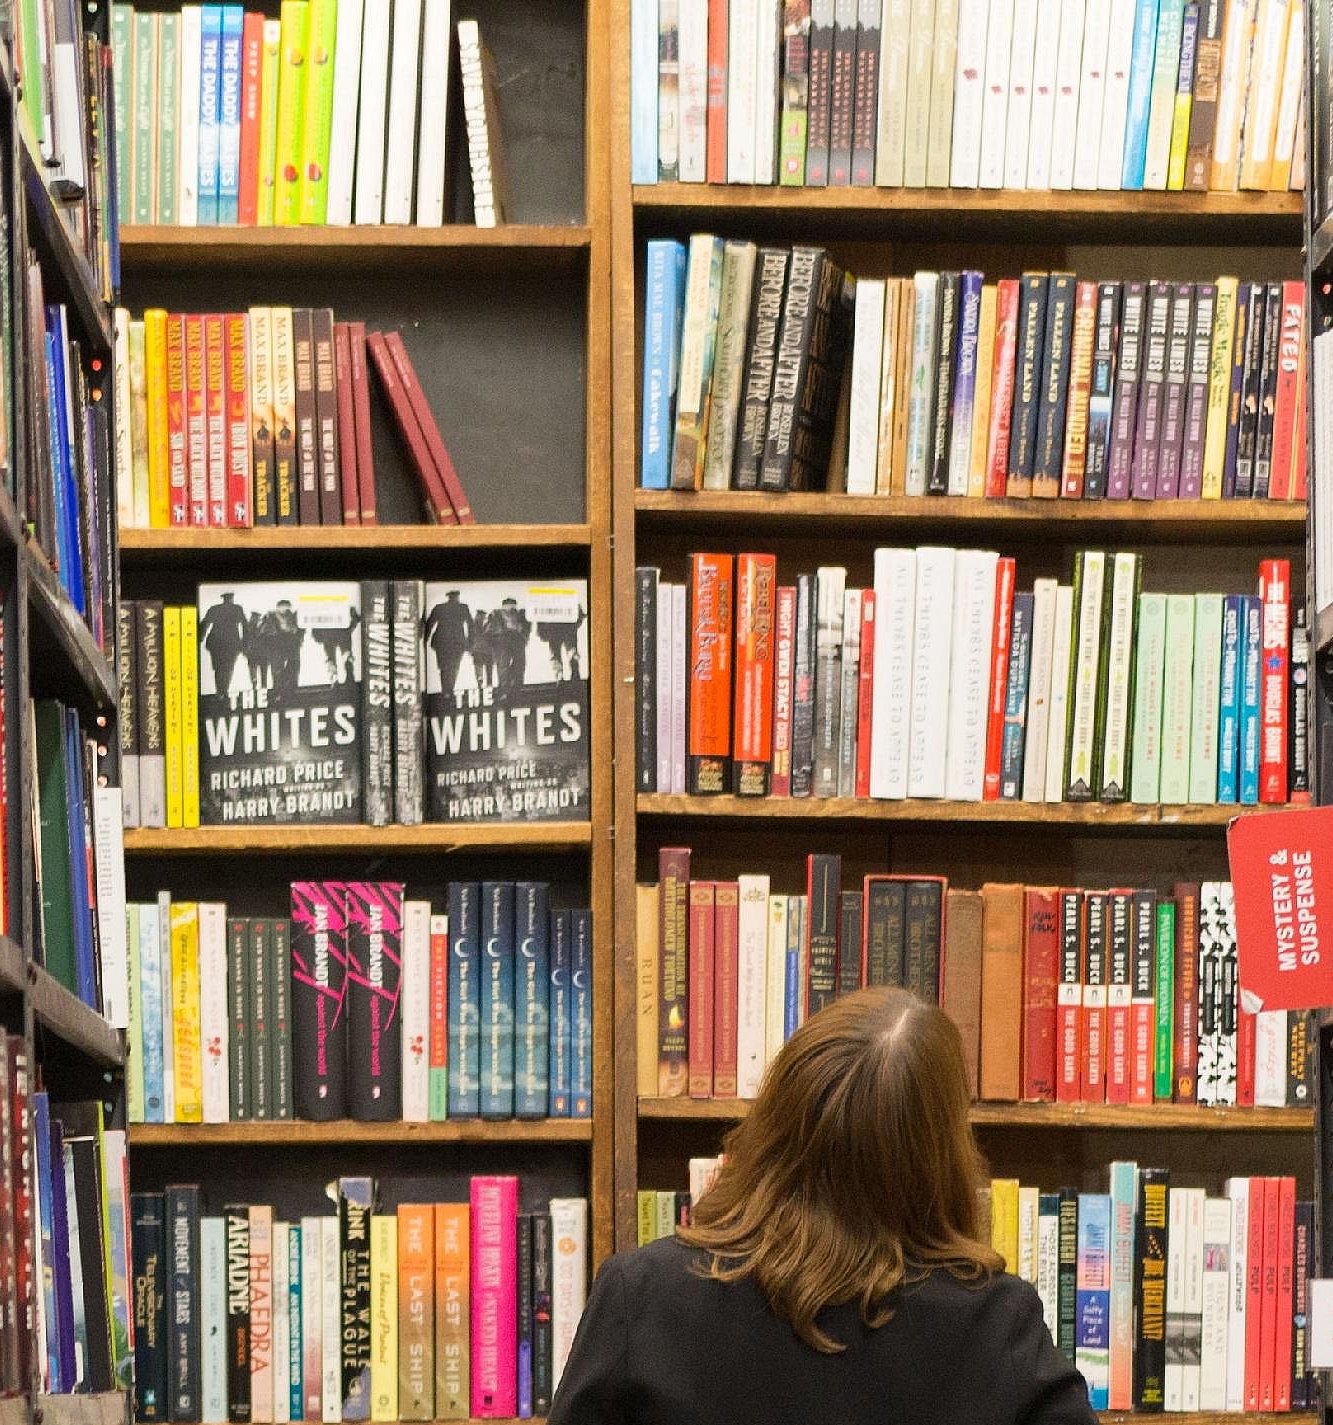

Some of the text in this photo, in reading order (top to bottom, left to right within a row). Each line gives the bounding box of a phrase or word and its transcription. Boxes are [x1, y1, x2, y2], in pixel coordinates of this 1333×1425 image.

[758, 254, 787, 318] BEFORE
[787, 254, 814, 318] BEFORE
[1023, 302, 1039, 402] FALLEN LAND
[1048, 302, 1065, 402] FALLEN LAND
[1170, 298, 1190, 373] WHITE LINES
[1193, 299, 1213, 373] WHITE LINES
[1282, 304, 1301, 373] FATED
[746, 347, 774, 400] AFTER
[773, 347, 800, 401] AFTER
[1069, 391, 1089, 454] MINDED
[144, 609, 160, 749] A MILLION HEAVENS
[778, 640, 791, 675] GWEN
[205, 705, 356, 757] WHITES
[227, 688, 269, 711] THE
[431, 703, 582, 756] WHITES
[454, 687, 494, 709] THE
[777, 679, 790, 720] STACY
[1265, 675, 1282, 764] DOUGLAS BRUNT
[1295, 688, 1306, 771] DOUGLAS BRUNT
[776, 722, 788, 750] DIED
[210, 760, 344, 791] RICHARD PRICE
[223, 791, 354, 821] HARRY BRANDT
[437, 761, 536, 787] RICHARD PRICE
[449, 789, 579, 818] HARRY BRANDT
[1065, 895, 1077, 982] PEARL S. BUCK
[1089, 897, 1101, 984] PEARL S. BUCK
[1269, 848, 1297, 971] MYSTERY &
[1292, 850, 1320, 965] SUSPENSE
[315, 904, 328, 988] JAN BRANDT
[369, 904, 383, 989] JAN BRANDT
[1139, 902, 1150, 991] PEARL S. BUCK
[435, 967, 443, 1019] FICTION
[1064, 1010, 1074, 1083] THE GOOD EARTH
[1089, 1012, 1099, 1084] THE GOOD EARTH
[229, 1216, 249, 1314] ARIADNE
[1039, 1259, 1047, 1290] RIVER
[1047, 1222, 1056, 1304] THOSE ACROSS
[249, 1254, 270, 1374] PHAEDRA
[343, 1289, 357, 1368] PLAGUE
[357, 1251, 370, 1368] THE WALL
[409, 1215, 422, 1393] THE LAST SHIP
[445, 1216, 459, 1394] THE LAST SHIP
